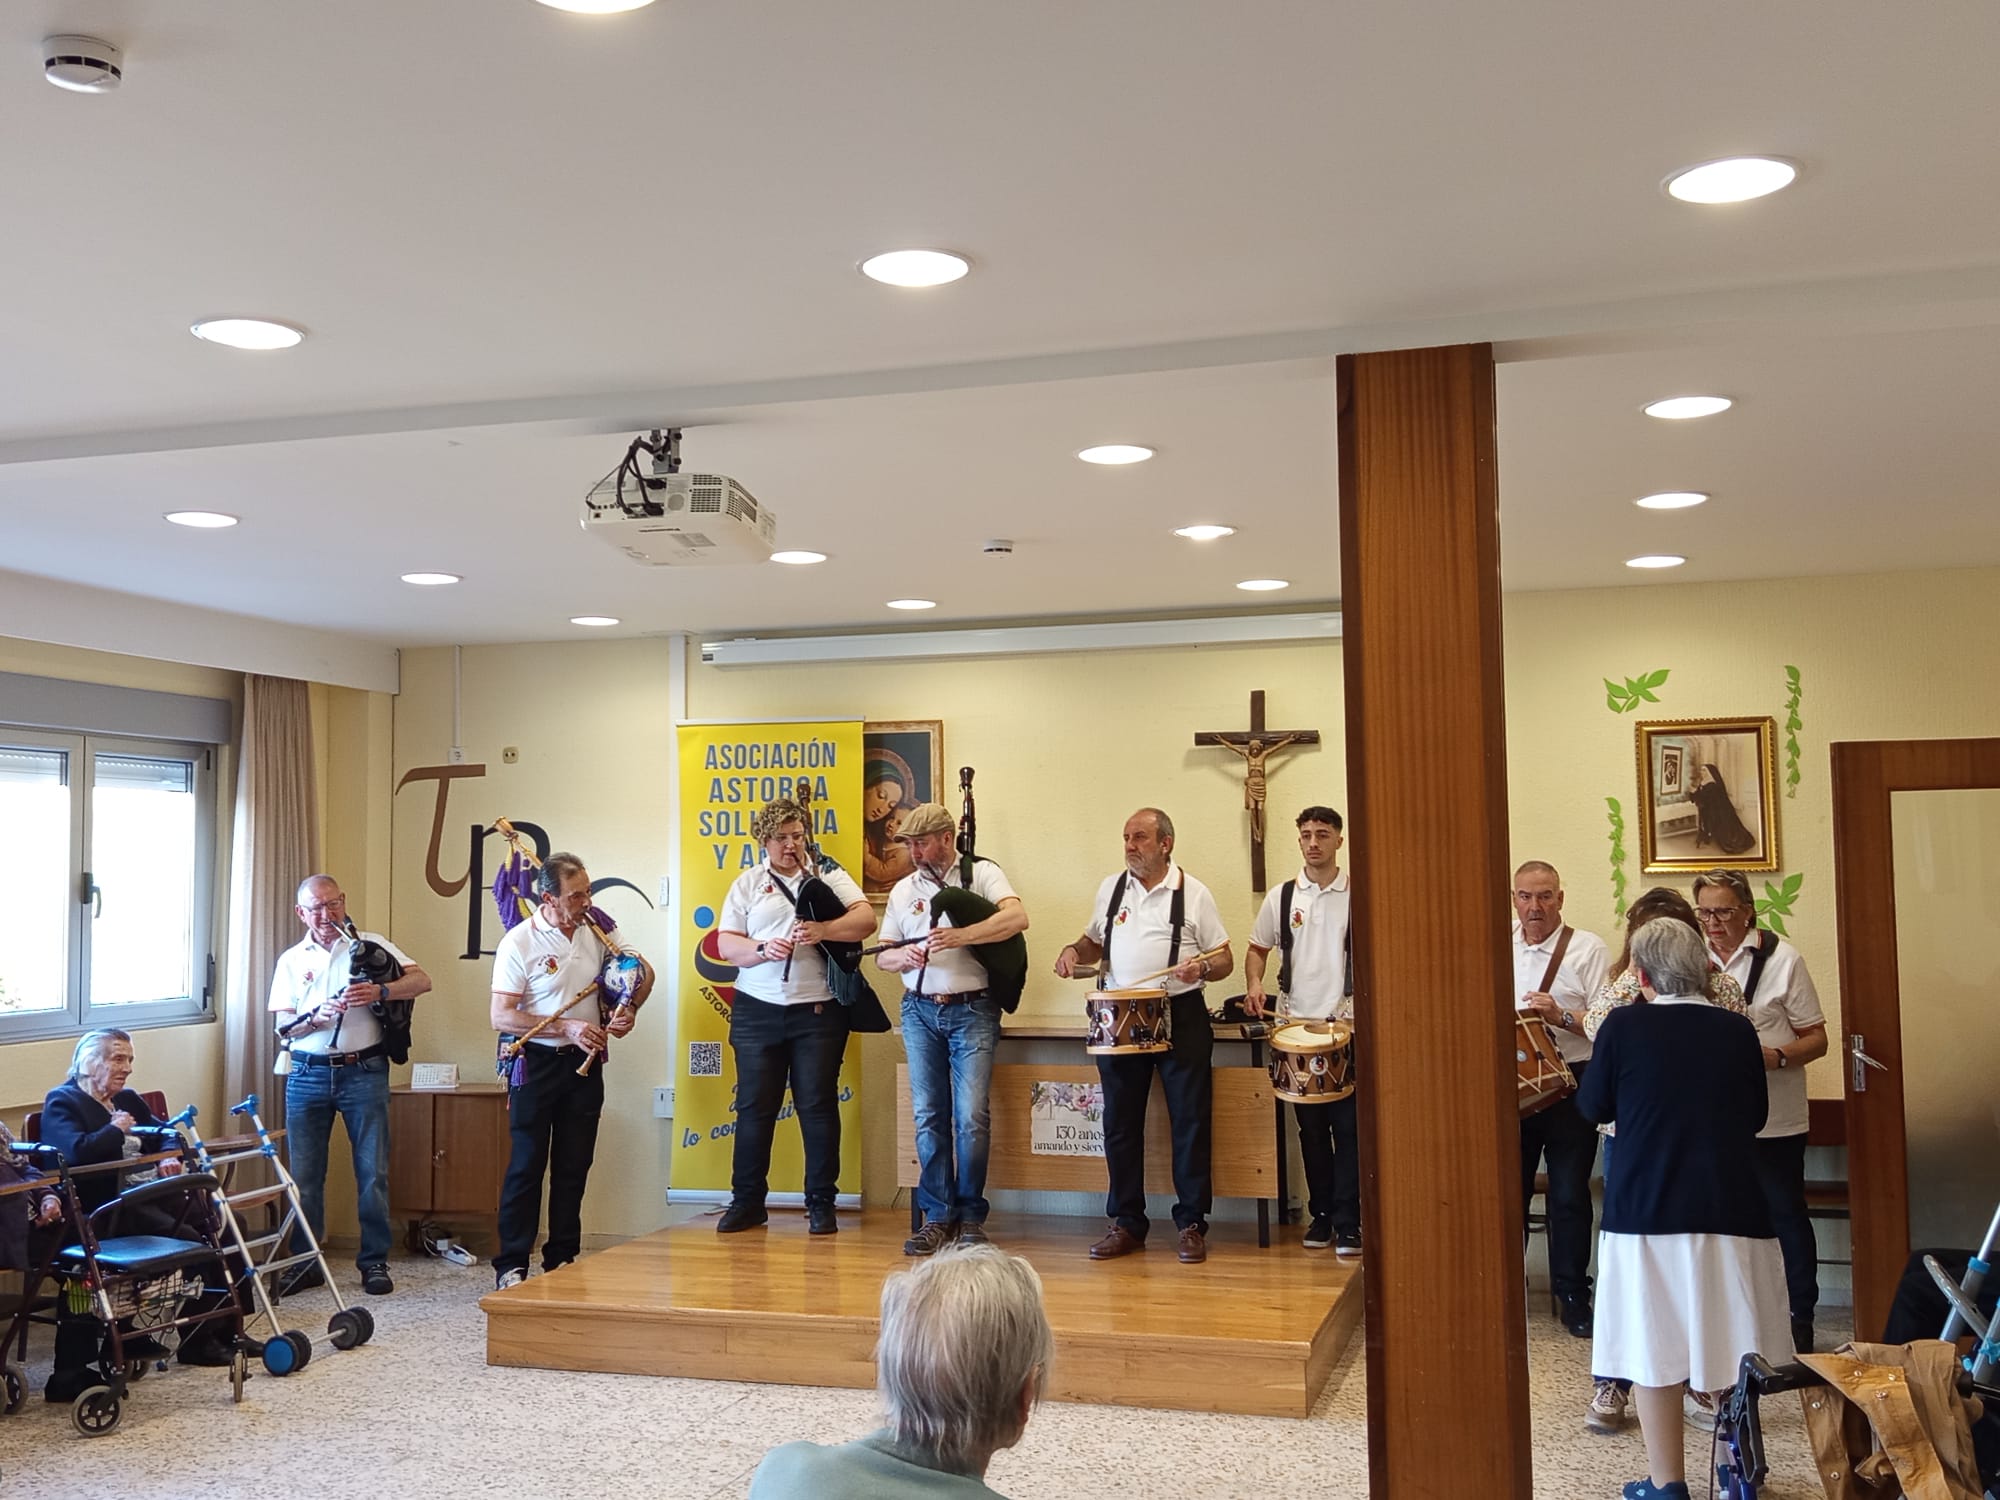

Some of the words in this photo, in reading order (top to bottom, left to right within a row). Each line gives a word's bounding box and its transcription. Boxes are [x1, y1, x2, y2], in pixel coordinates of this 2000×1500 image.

[704, 737, 836, 770] ASOCIACIÓN
[698, 808, 839, 837] SOLIA
[712, 843, 729, 870] Y
[682, 1127, 703, 1149] lo
[1034, 1140, 1072, 1151] amando
